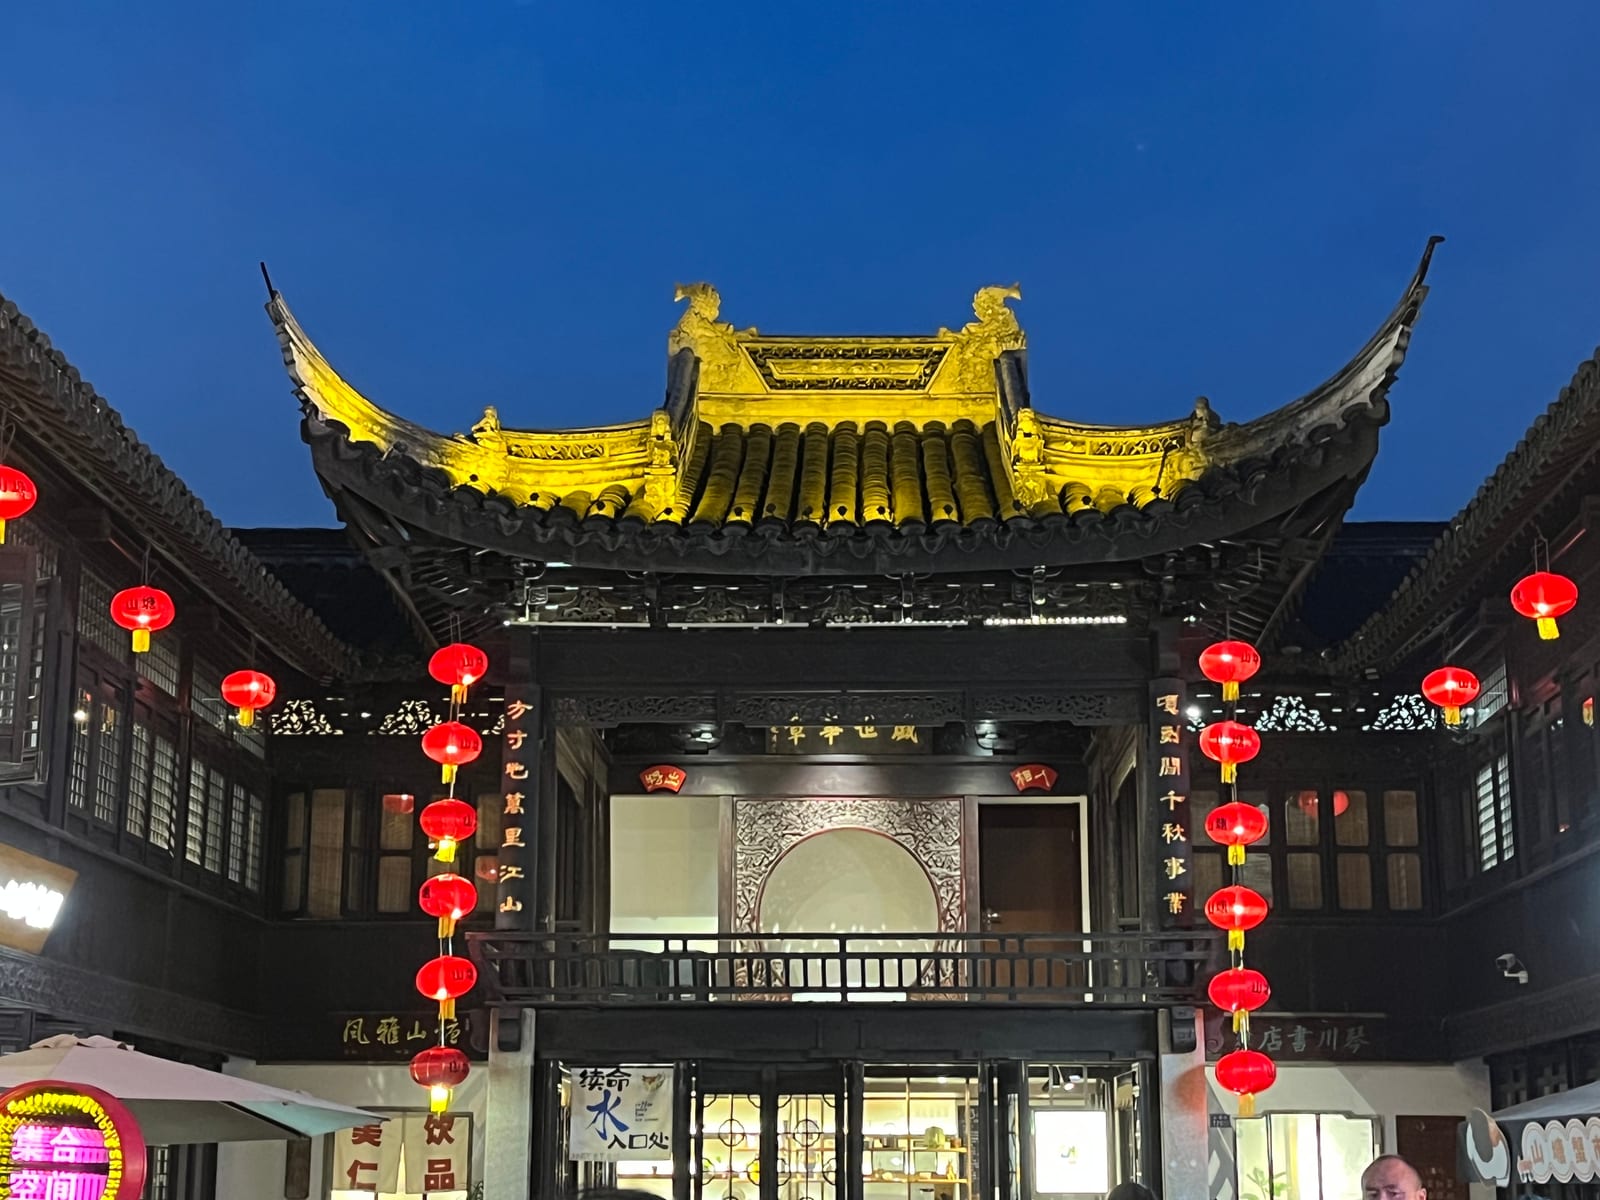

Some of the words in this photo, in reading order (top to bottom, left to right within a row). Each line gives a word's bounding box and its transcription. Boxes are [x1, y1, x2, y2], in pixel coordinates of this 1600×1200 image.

[579, 1068, 632, 1092] 续命
[585, 1088, 630, 1141] 水
[10, 1125, 82, 1162] 集合
[424, 1114, 455, 1191] 饮品
[607, 1131, 669, 1150] 入口处
[9, 1170, 80, 1200] 空间
